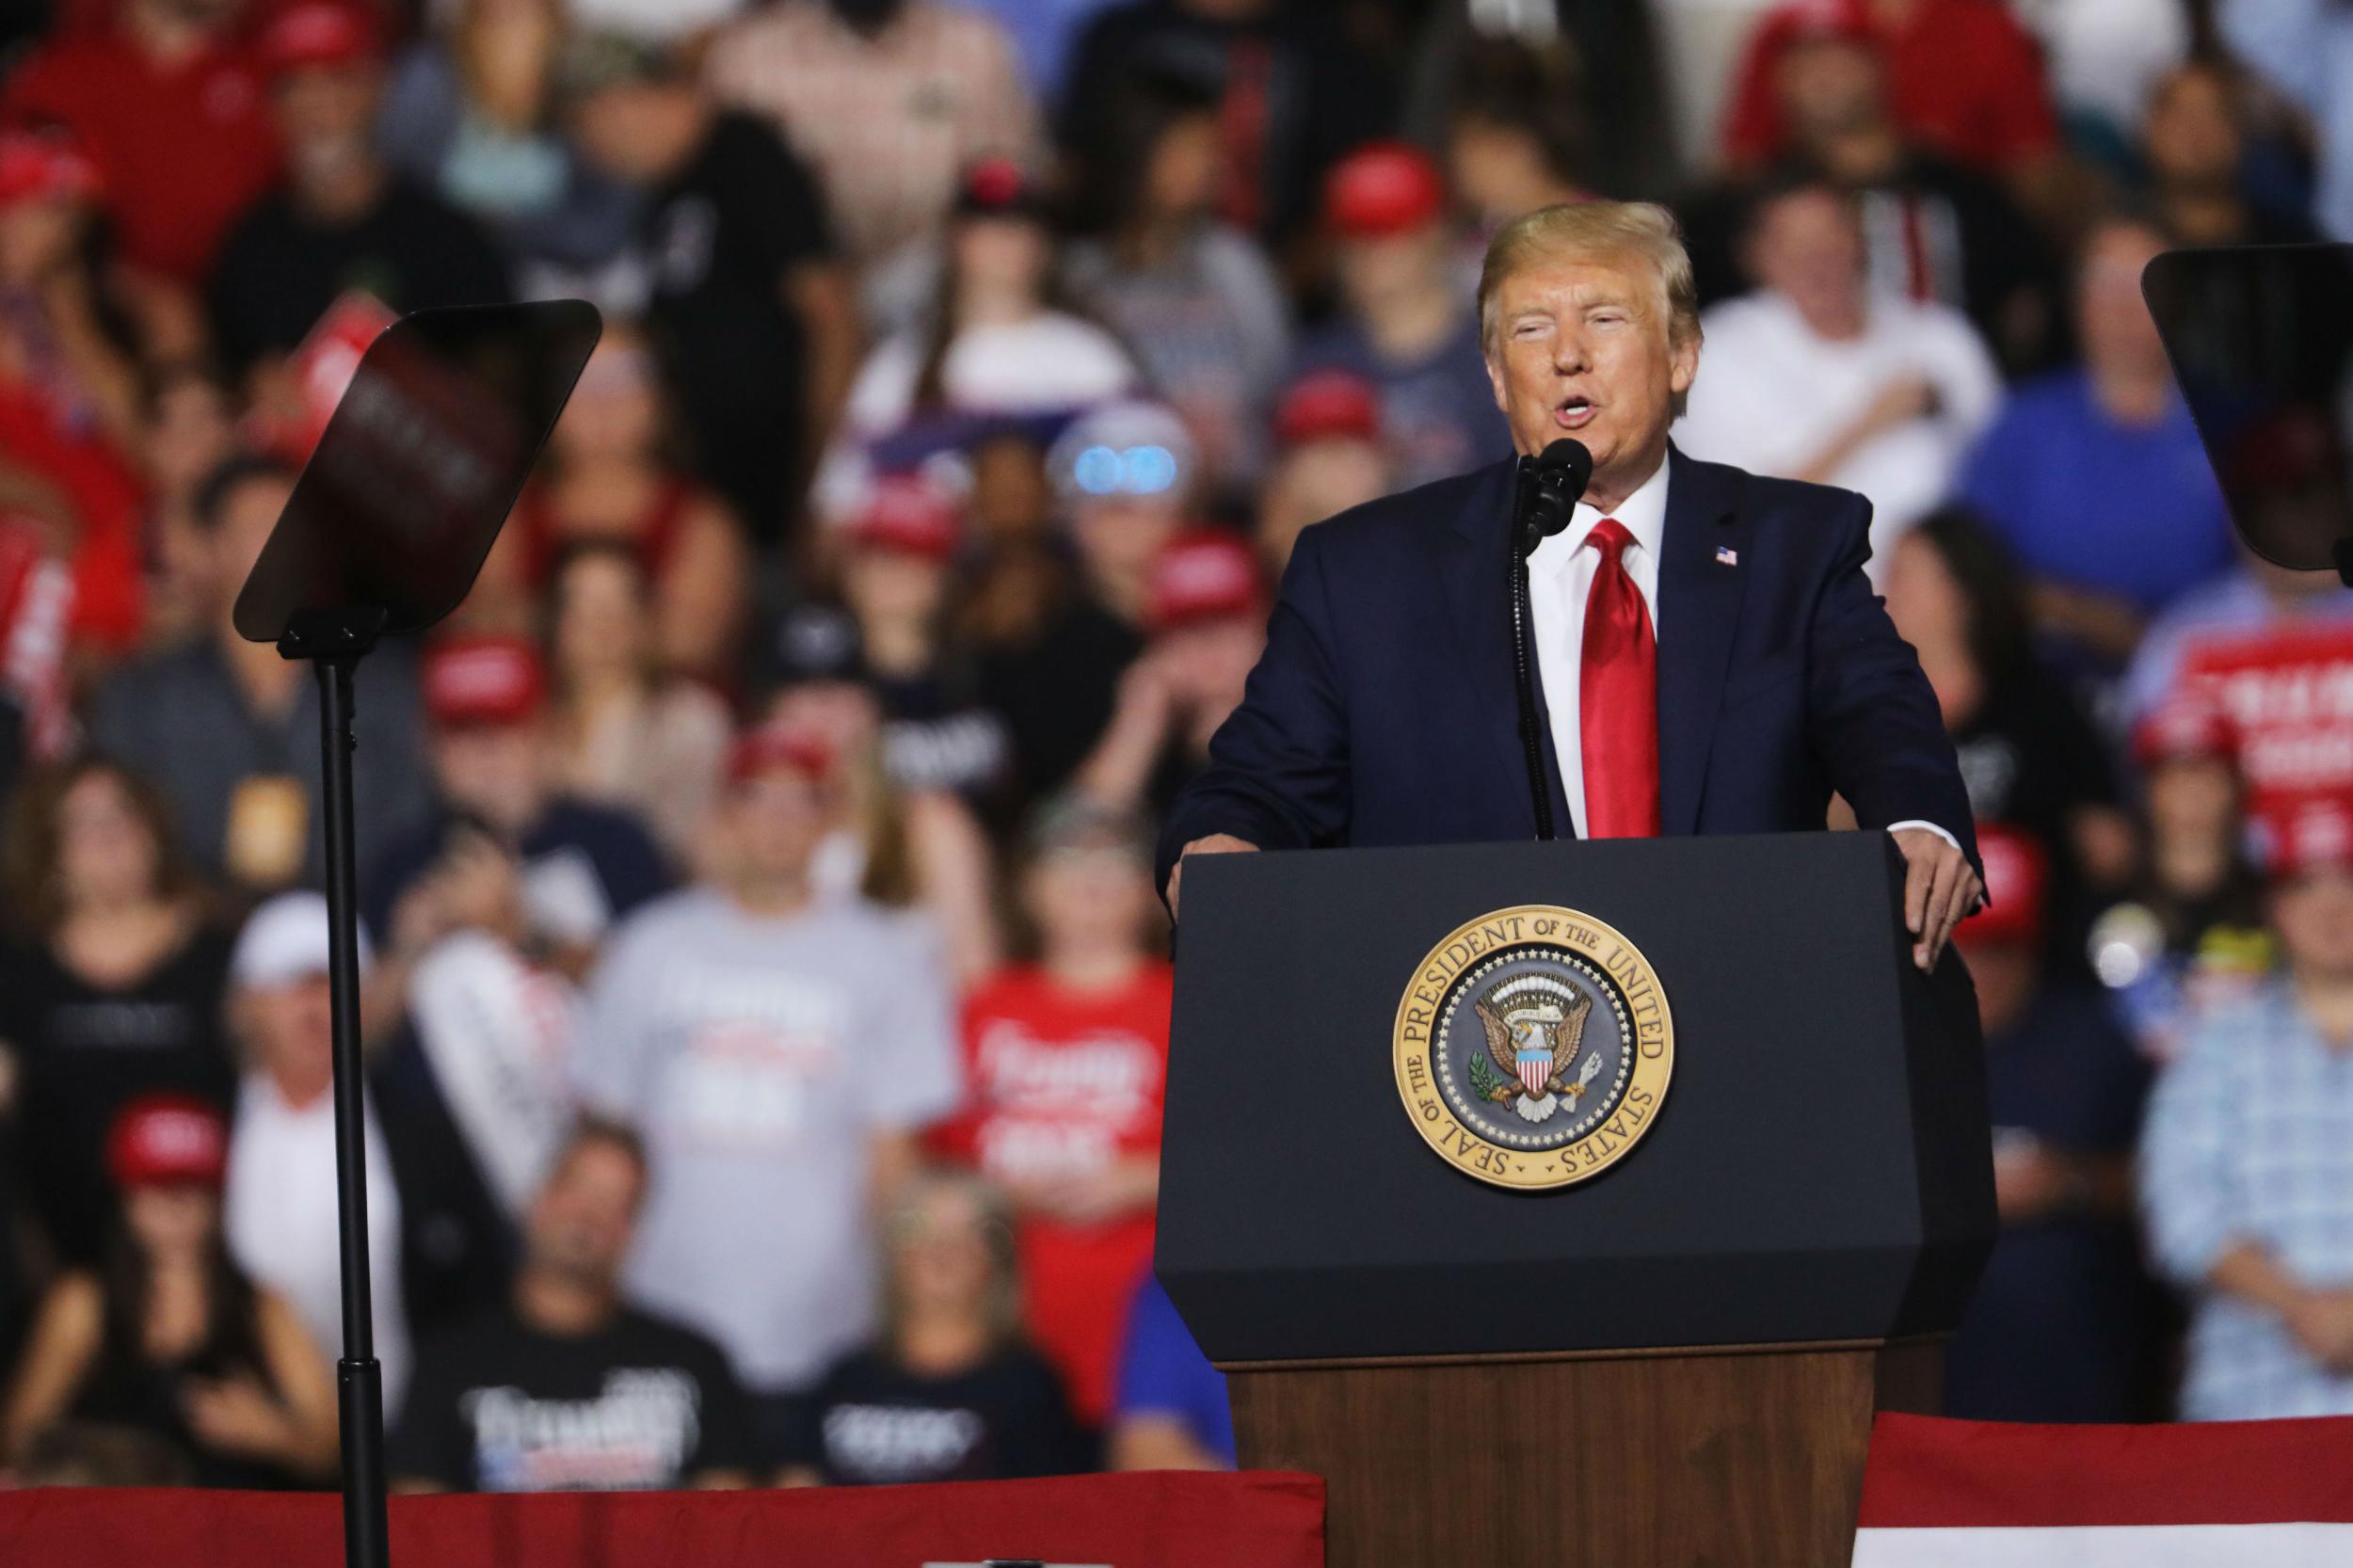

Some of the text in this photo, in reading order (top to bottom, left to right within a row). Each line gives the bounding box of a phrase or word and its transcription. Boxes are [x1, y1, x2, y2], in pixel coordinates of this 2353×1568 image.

[1402, 917, 1665, 1176] SEAL OF THE PRESIDENT OF THE UNITED STATES
